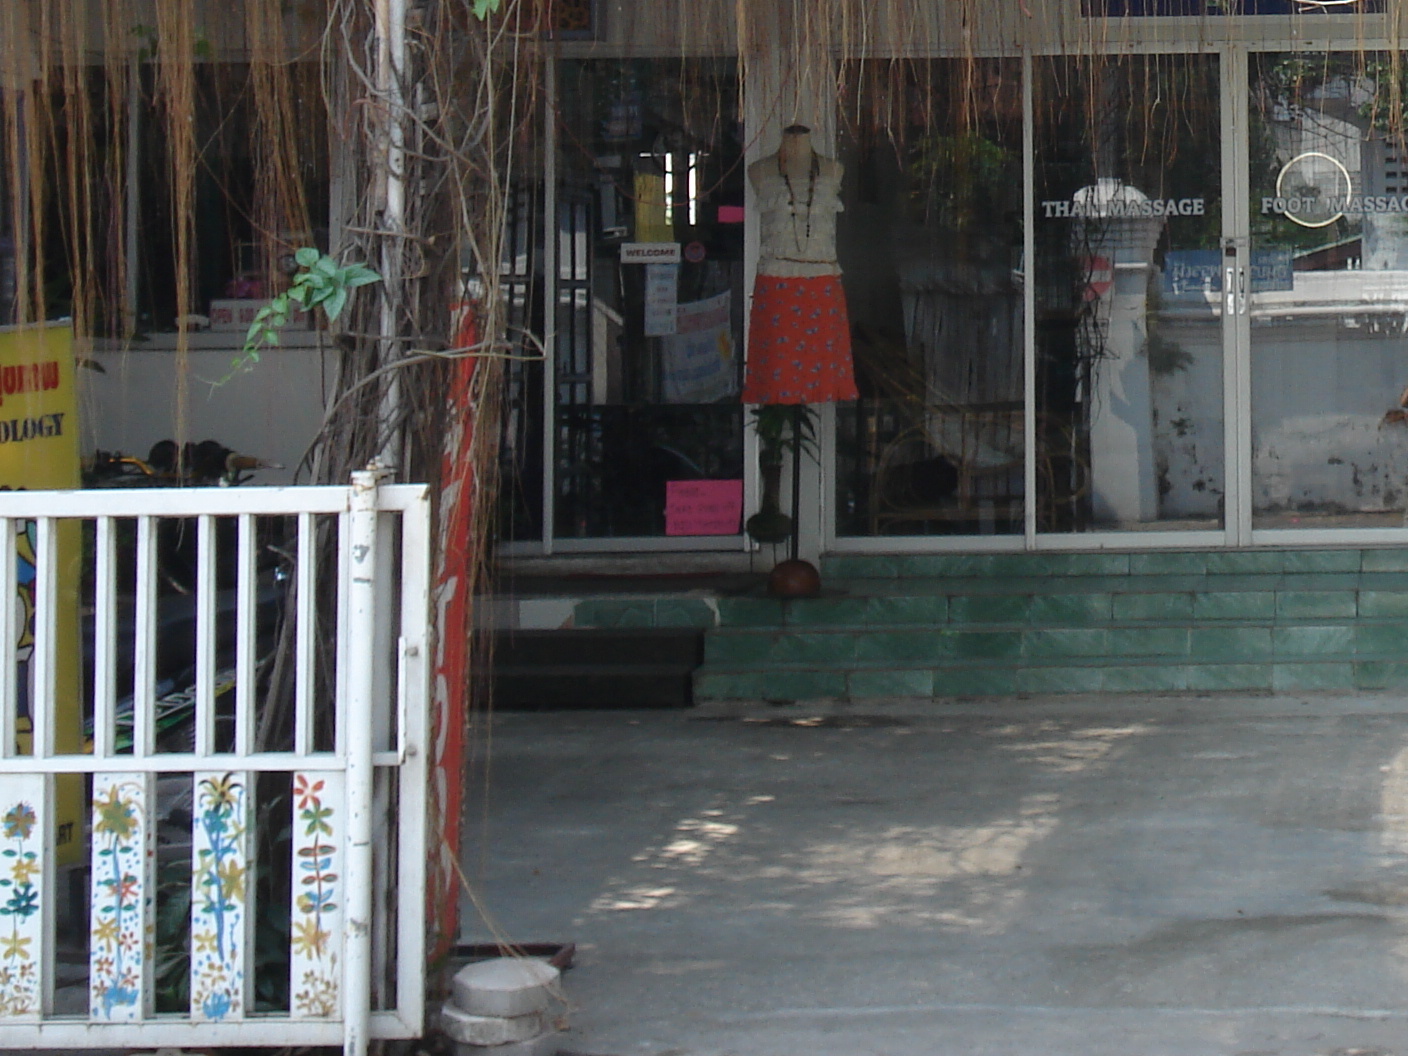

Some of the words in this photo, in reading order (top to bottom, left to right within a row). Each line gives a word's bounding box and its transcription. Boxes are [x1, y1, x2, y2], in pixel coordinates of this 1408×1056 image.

[1106, 198, 1205, 217] MASSAGE
[1261, 197, 1316, 214] FOOT
[626, 248, 676, 257] WELCOME
